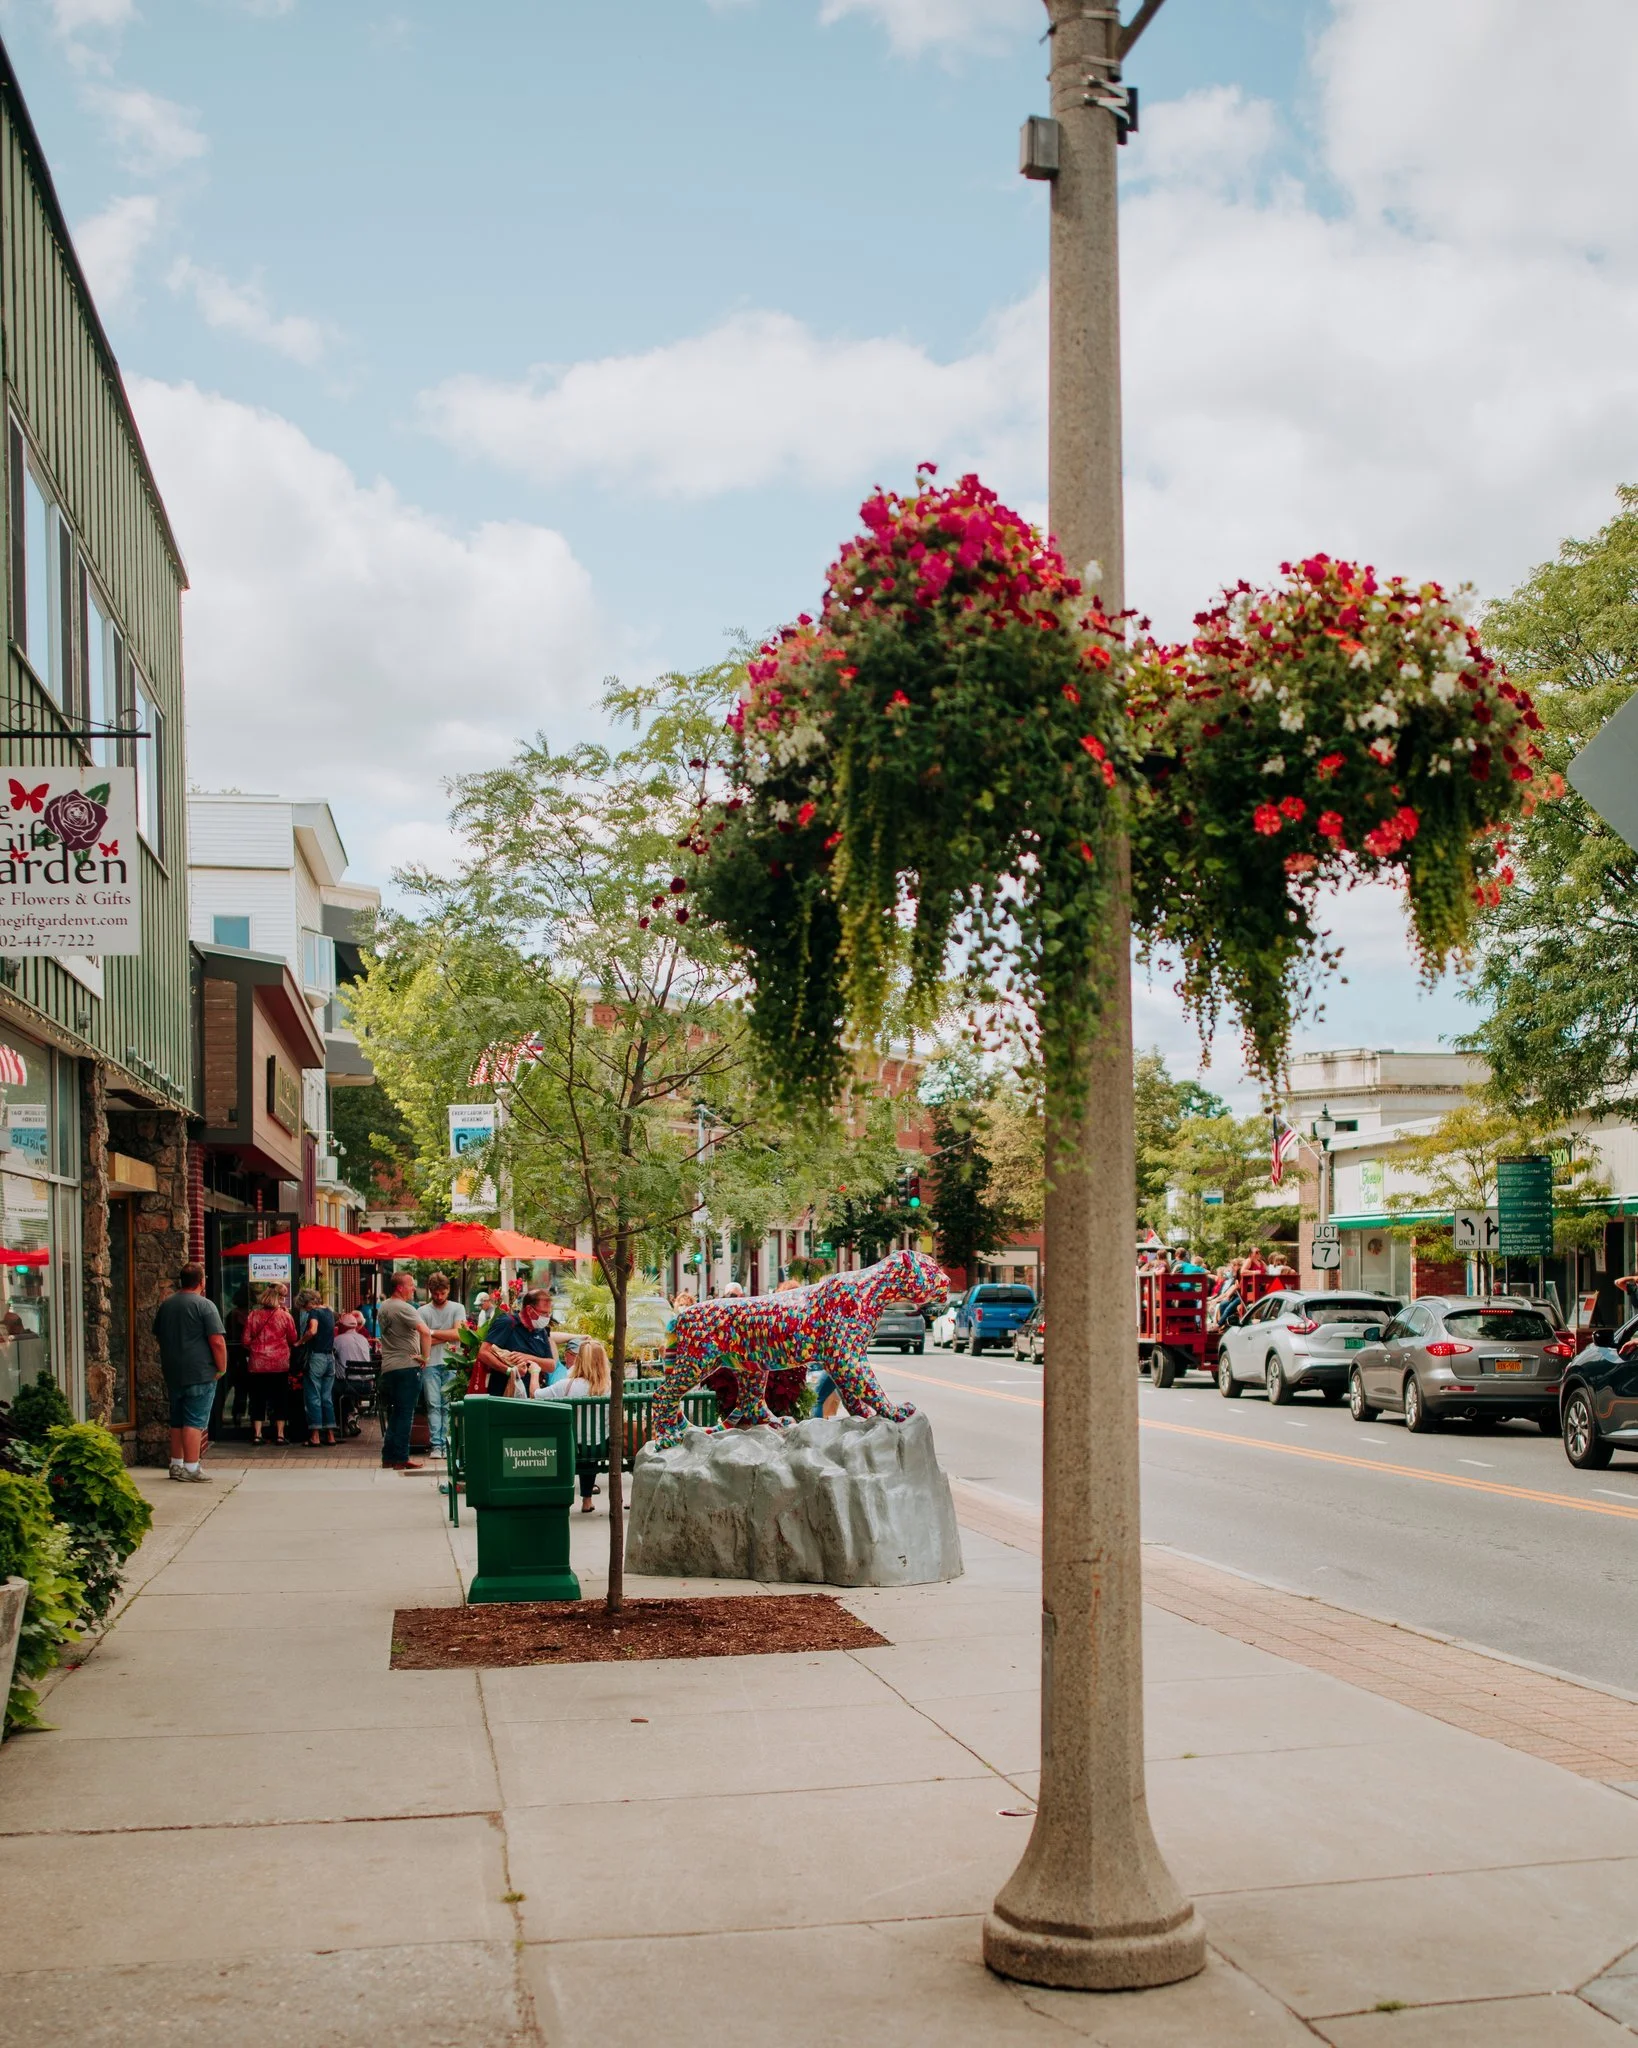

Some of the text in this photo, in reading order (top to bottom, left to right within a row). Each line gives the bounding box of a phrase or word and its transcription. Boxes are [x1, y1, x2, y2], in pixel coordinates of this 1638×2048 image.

[11, 891, 70, 906] Flowers
[75, 892, 87, 906] &
[93, 890, 131, 905] Gifts
[1316, 1226, 1337, 1238] JCT
[1321, 1247, 1331, 1262] 7
[503, 1446, 557, 1457] Manchester
[512, 1456, 548, 1469] Journal
